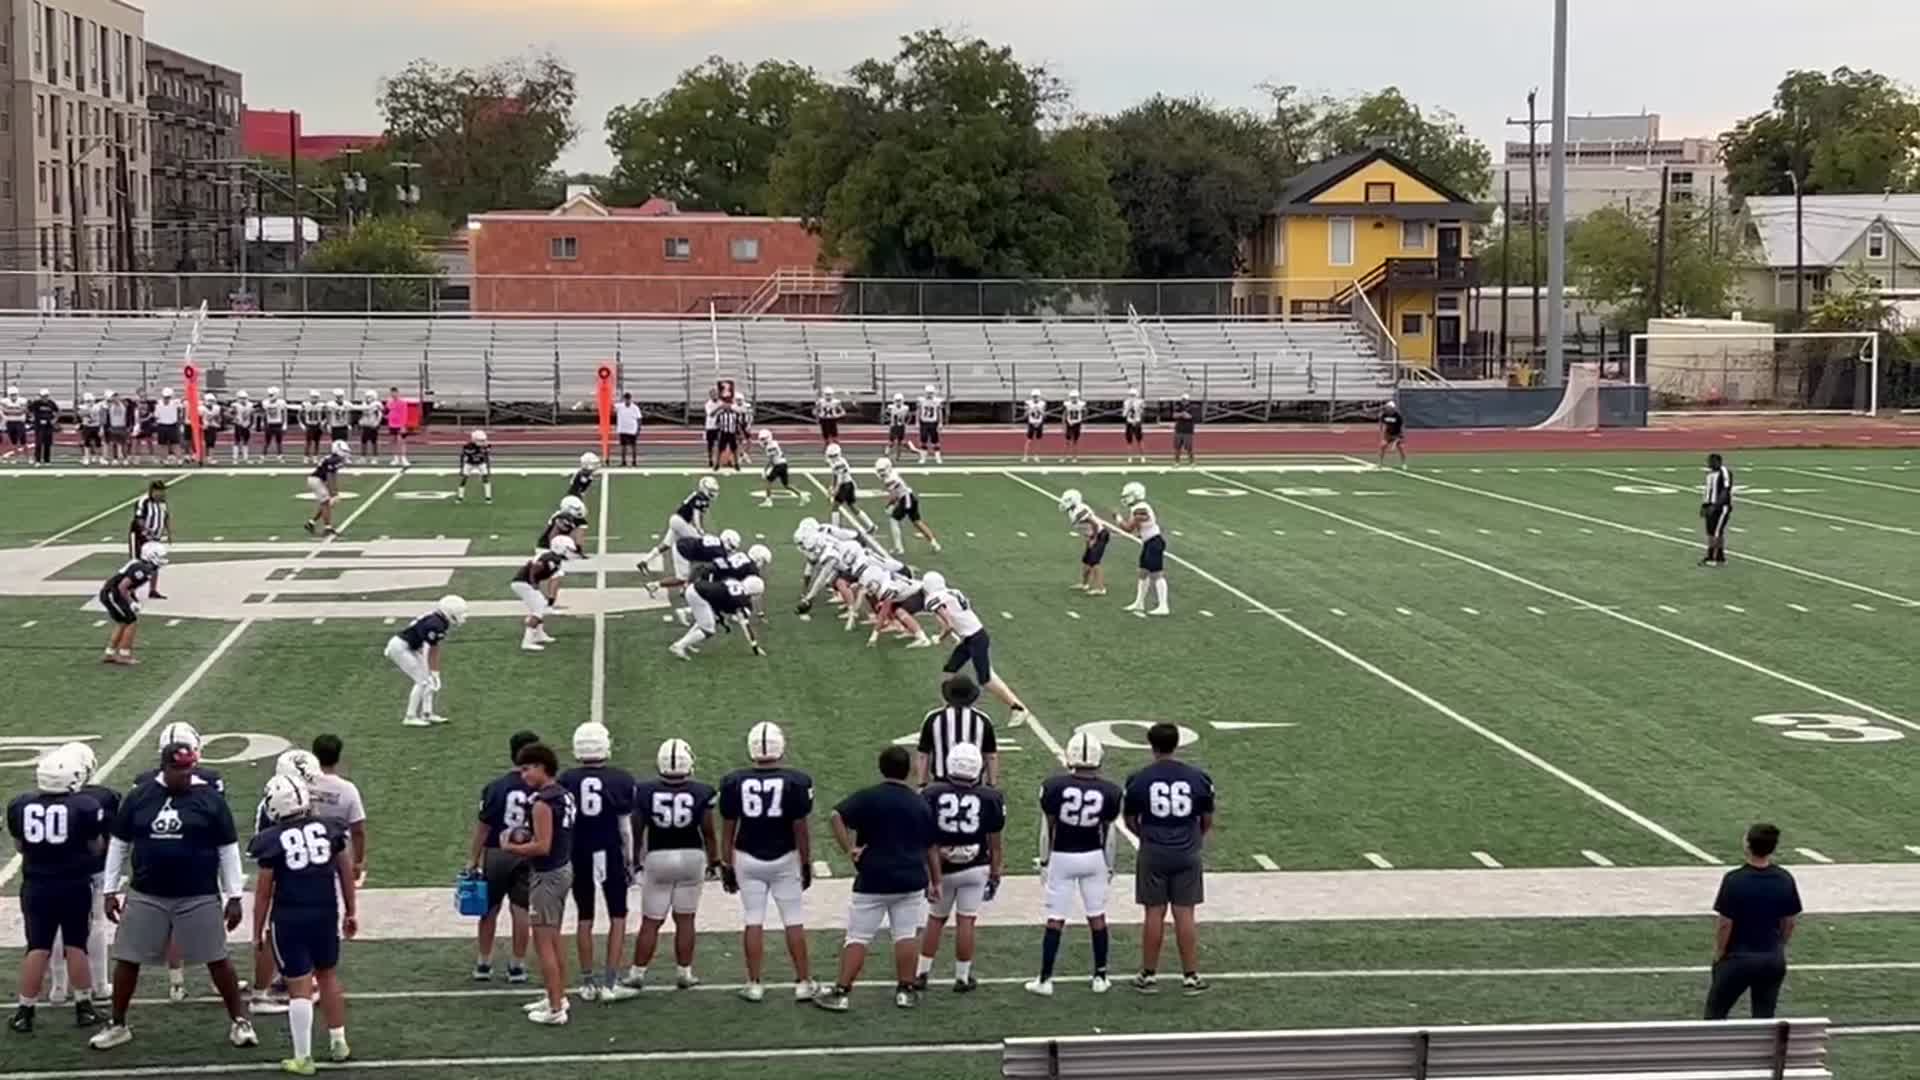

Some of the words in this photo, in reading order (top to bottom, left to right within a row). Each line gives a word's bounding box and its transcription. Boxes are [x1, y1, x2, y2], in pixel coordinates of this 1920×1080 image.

[1751, 712, 1906, 743] 3
[504, 790, 540, 827] 6
[580, 777, 602, 816] 6
[652, 793, 694, 827] 56
[741, 778, 784, 817] 67
[938, 794, 981, 833] 23
[1060, 787, 1103, 827] 22
[1149, 781, 1192, 817] 66
[23, 803, 67, 843] 60
[280, 821, 331, 870] 86
